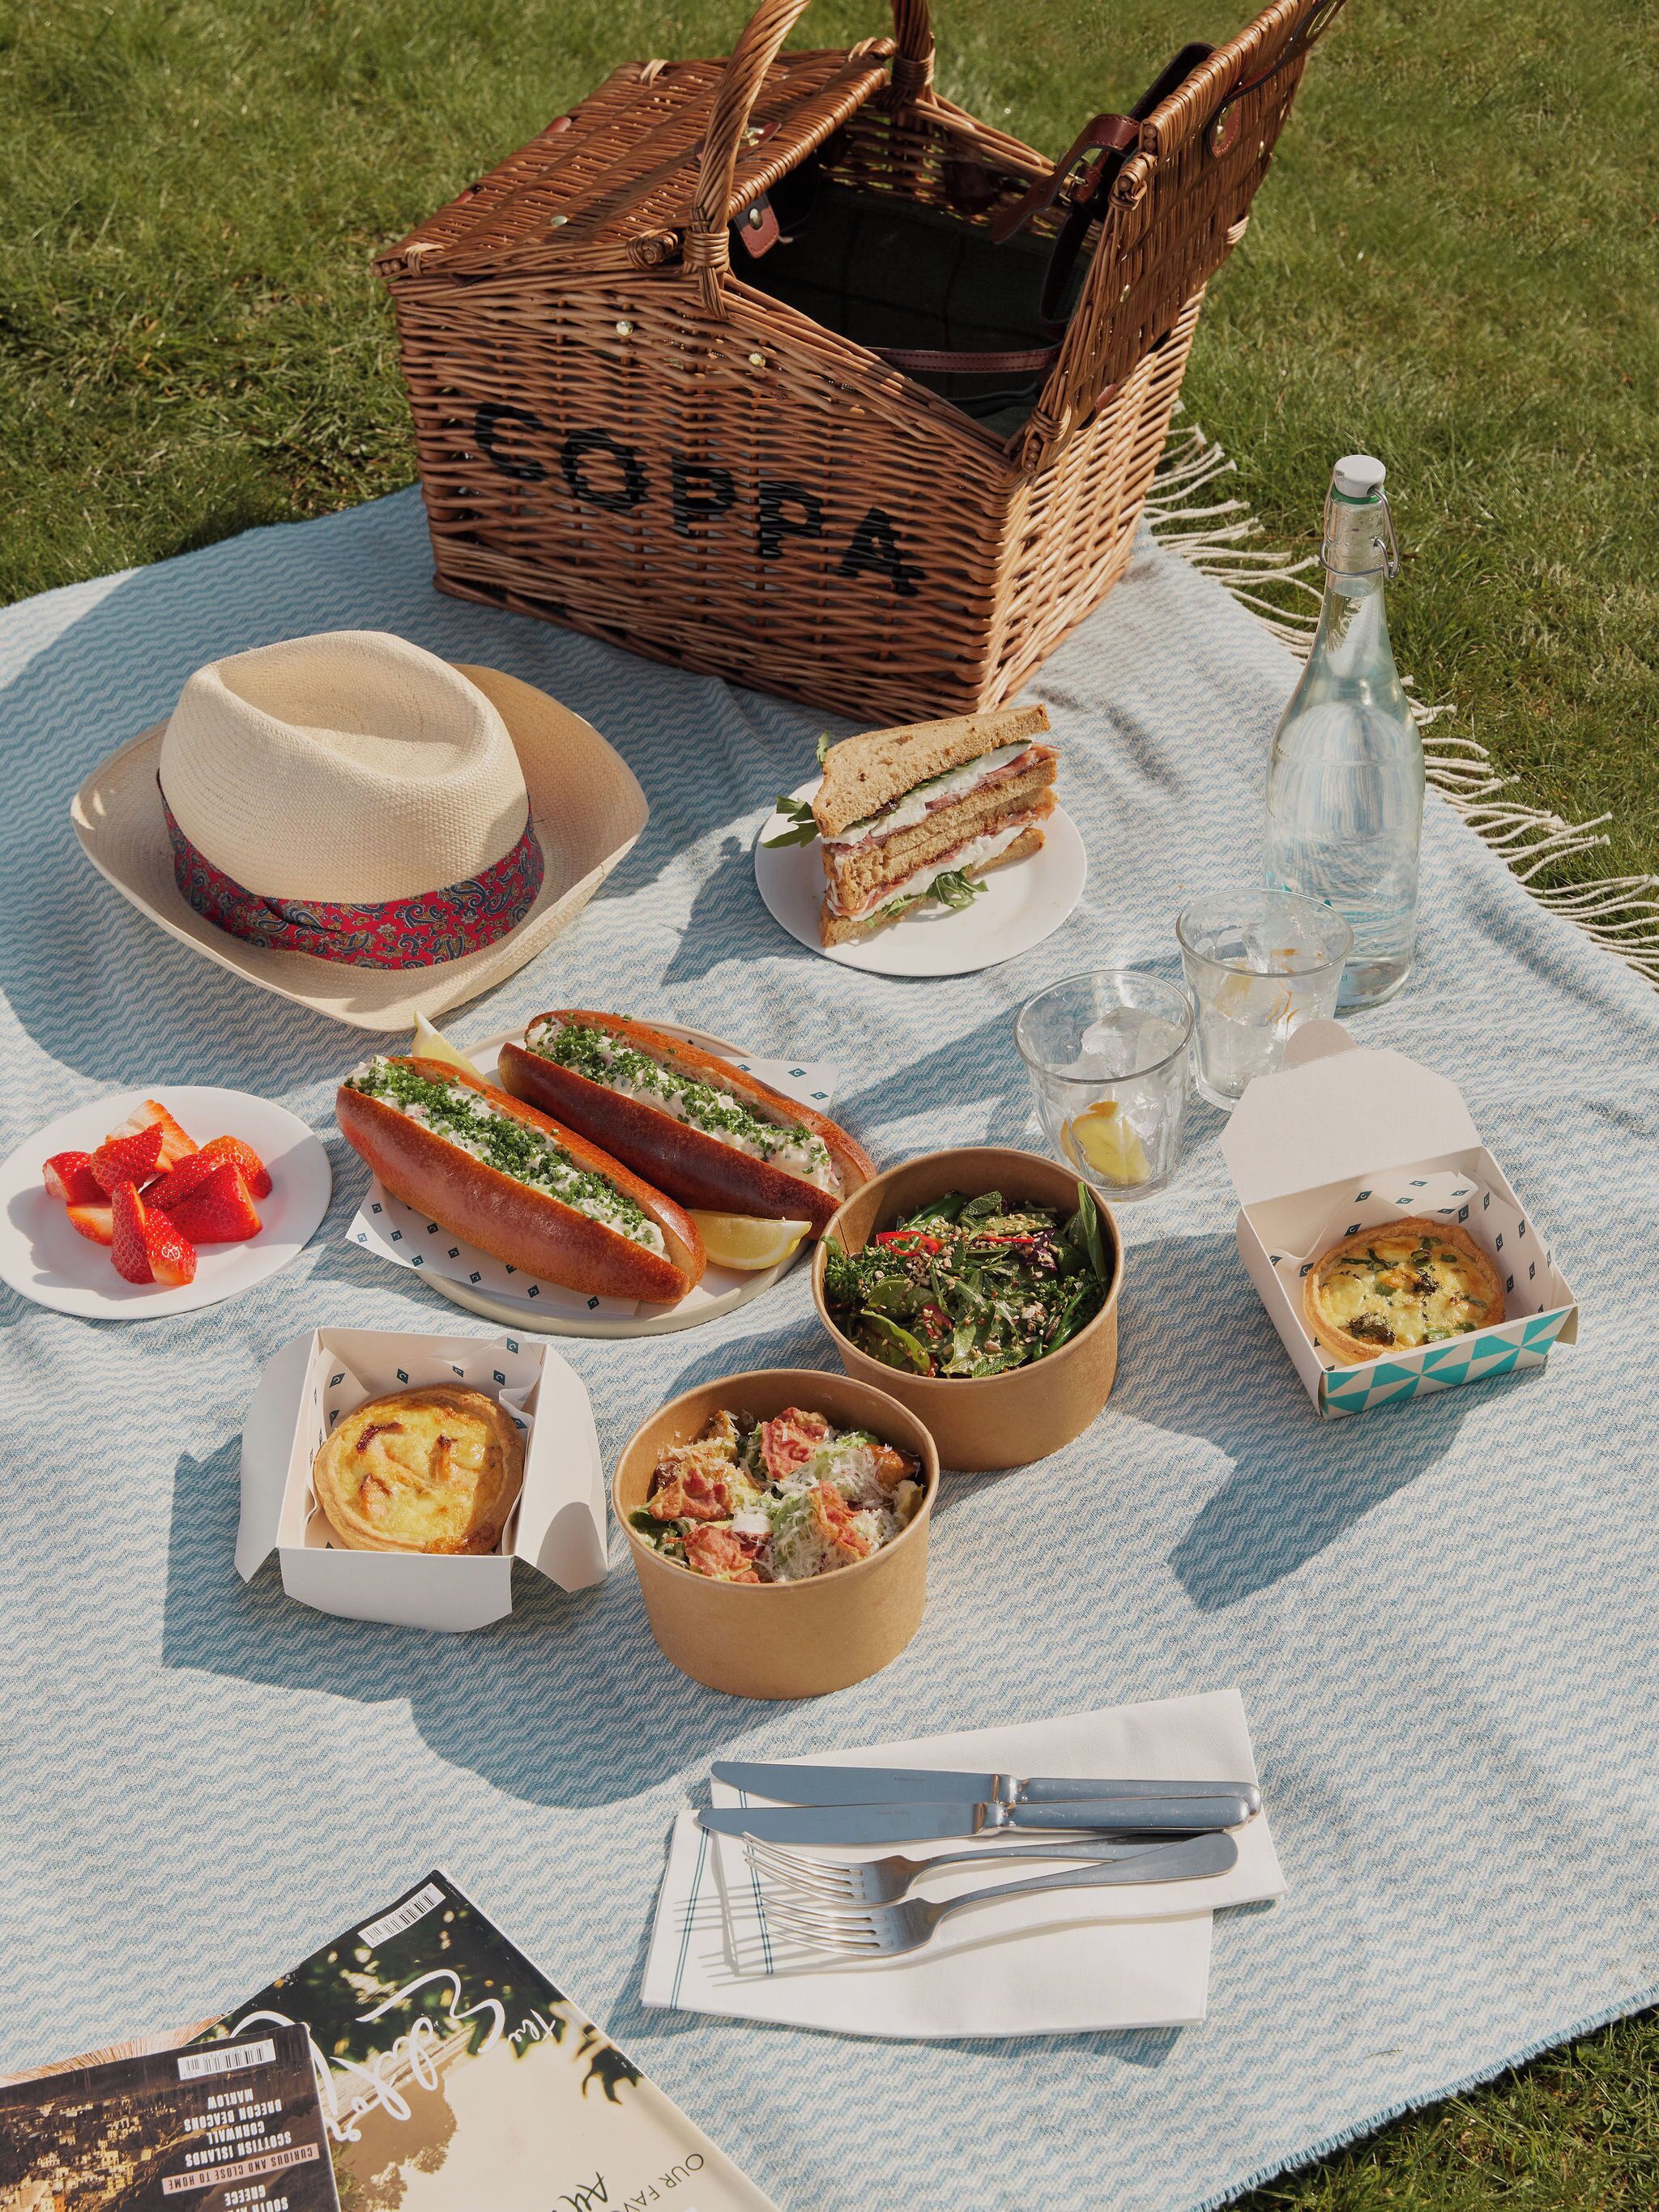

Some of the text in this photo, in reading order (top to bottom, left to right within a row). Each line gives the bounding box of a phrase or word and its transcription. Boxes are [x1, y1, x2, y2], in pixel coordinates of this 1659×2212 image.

[474, 402, 926, 598] COPPA
[183, 2099, 282, 2132] BRECON BEACONS
[207, 2088, 254, 2109] MARLOW
[185, 2131, 292, 2167] SCOTTISH ISLANDS
[207, 2120, 265, 2145] CORNWALL
[168, 2148, 313, 2190] CURIOUS AND CLOSE TO HOME
[610, 2154, 704, 2212] OUR FAV
[224, 2184, 266, 2206] GREECE
